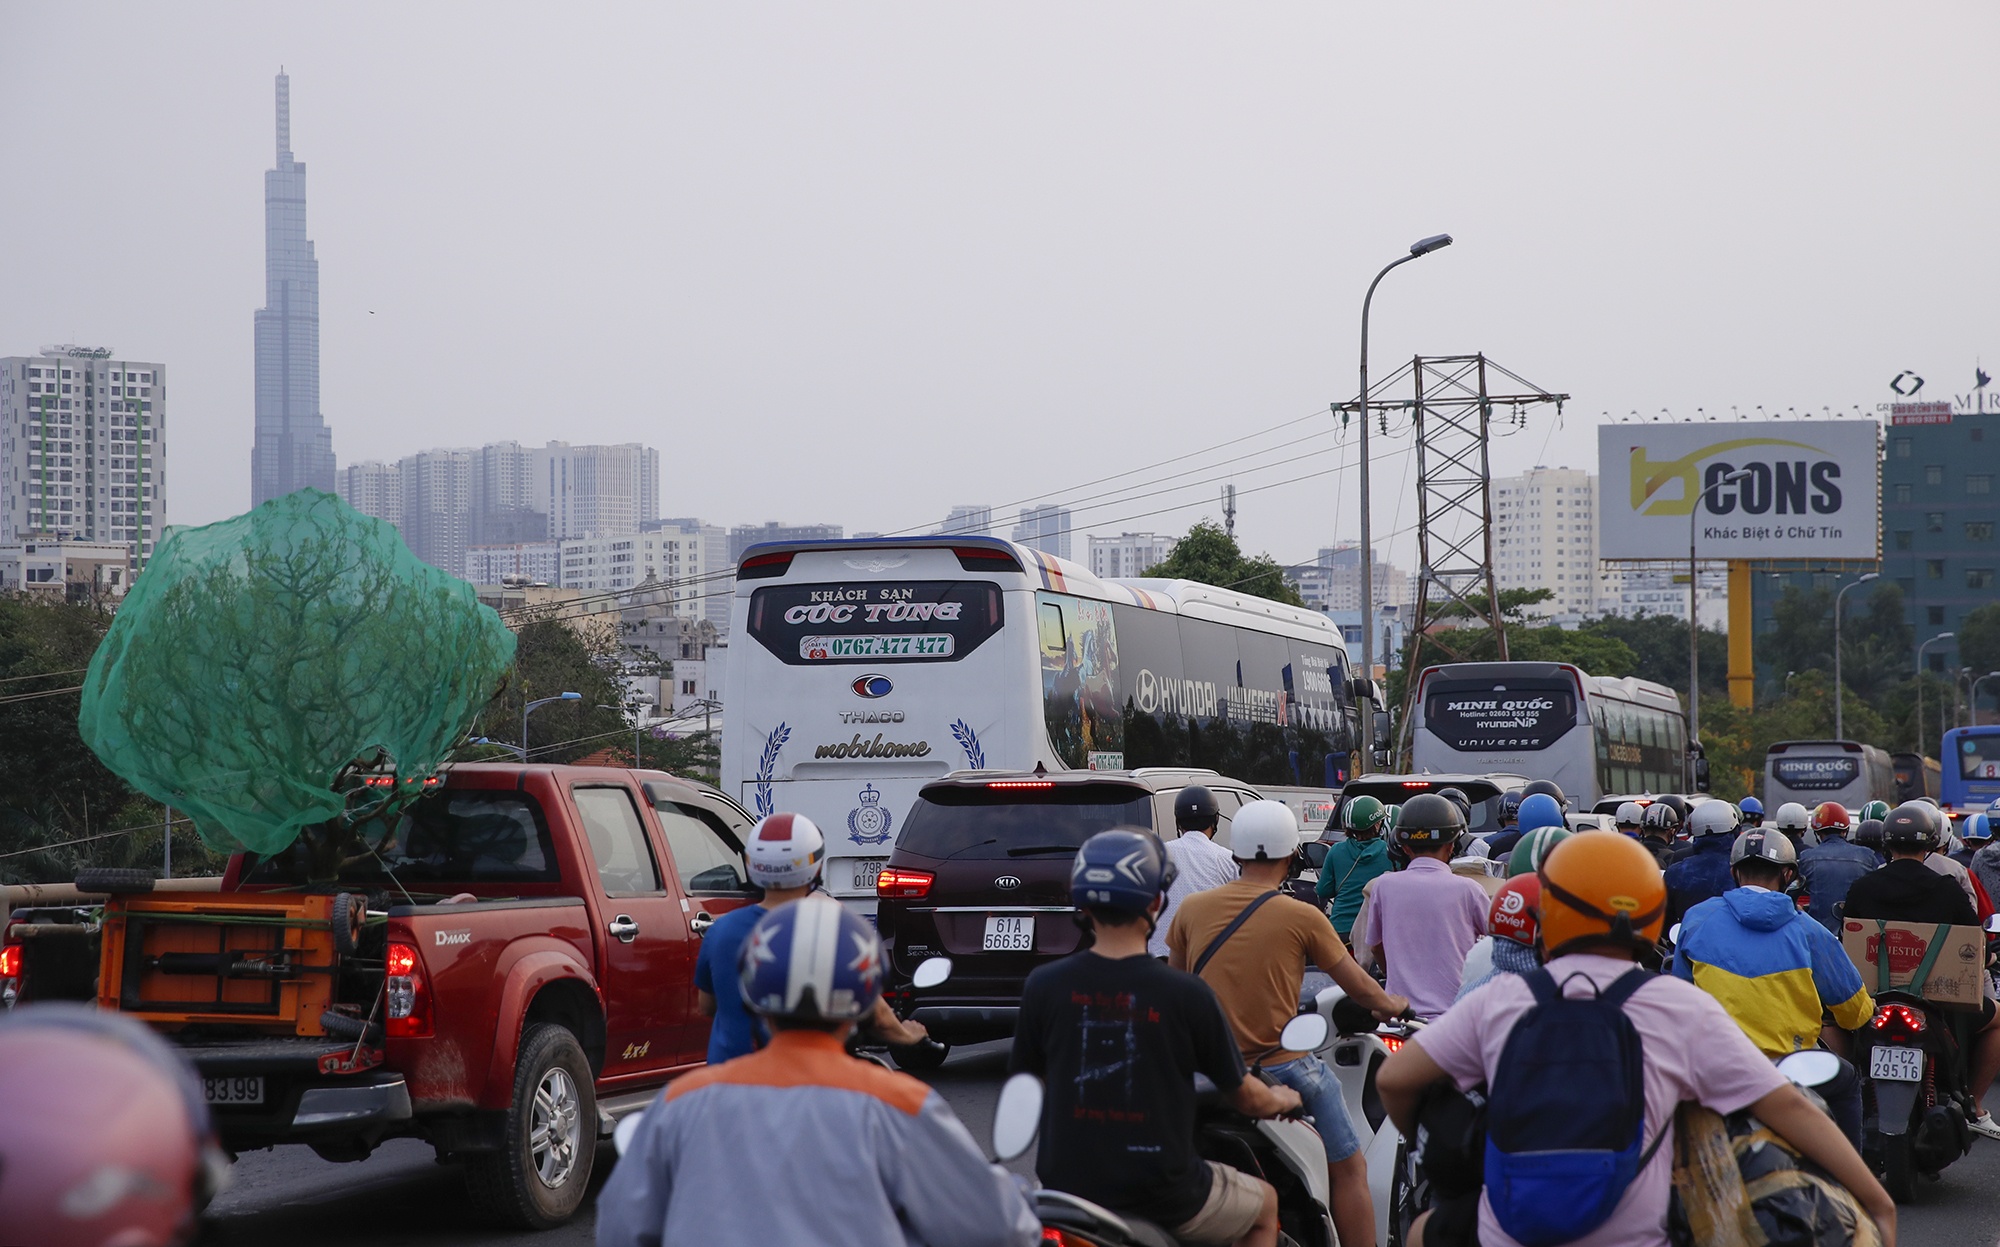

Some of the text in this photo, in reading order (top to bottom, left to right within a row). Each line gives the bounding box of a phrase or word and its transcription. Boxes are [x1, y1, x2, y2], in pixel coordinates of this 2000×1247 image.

[1704, 525, 1842, 541] Khác Biệt ở Chữ Tín
[810, 587, 914, 603] KHÁCH SẠN
[864, 600, 963, 623] TÙNG
[1160, 675, 1218, 717] HYUNDAI
[1447, 697, 1553, 711] MINH QUỐC
[839, 710, 905, 724] THACO
[814, 732, 932, 759] mobihome
[1779, 759, 1852, 772] MINH QUỐC
[1368, 809, 1383, 821] Grab
[753, 861, 793, 874] HDBank
[862, 862, 882, 874] 79B
[854, 874, 878, 887] 010.
[998, 878, 1016, 887] KIA
[996, 918, 1021, 933] 61A
[1494, 911, 1526, 929] goviet
[985, 934, 1030, 949] 566.53
[1869, 944, 1922, 958] MJESTIC
[622, 1041, 650, 1060] 4x4
[1880, 1049, 1915, 1065] 71-C2
[1874, 1063, 1919, 1079] 295.16
[203, 1077, 259, 1102] 83.99
